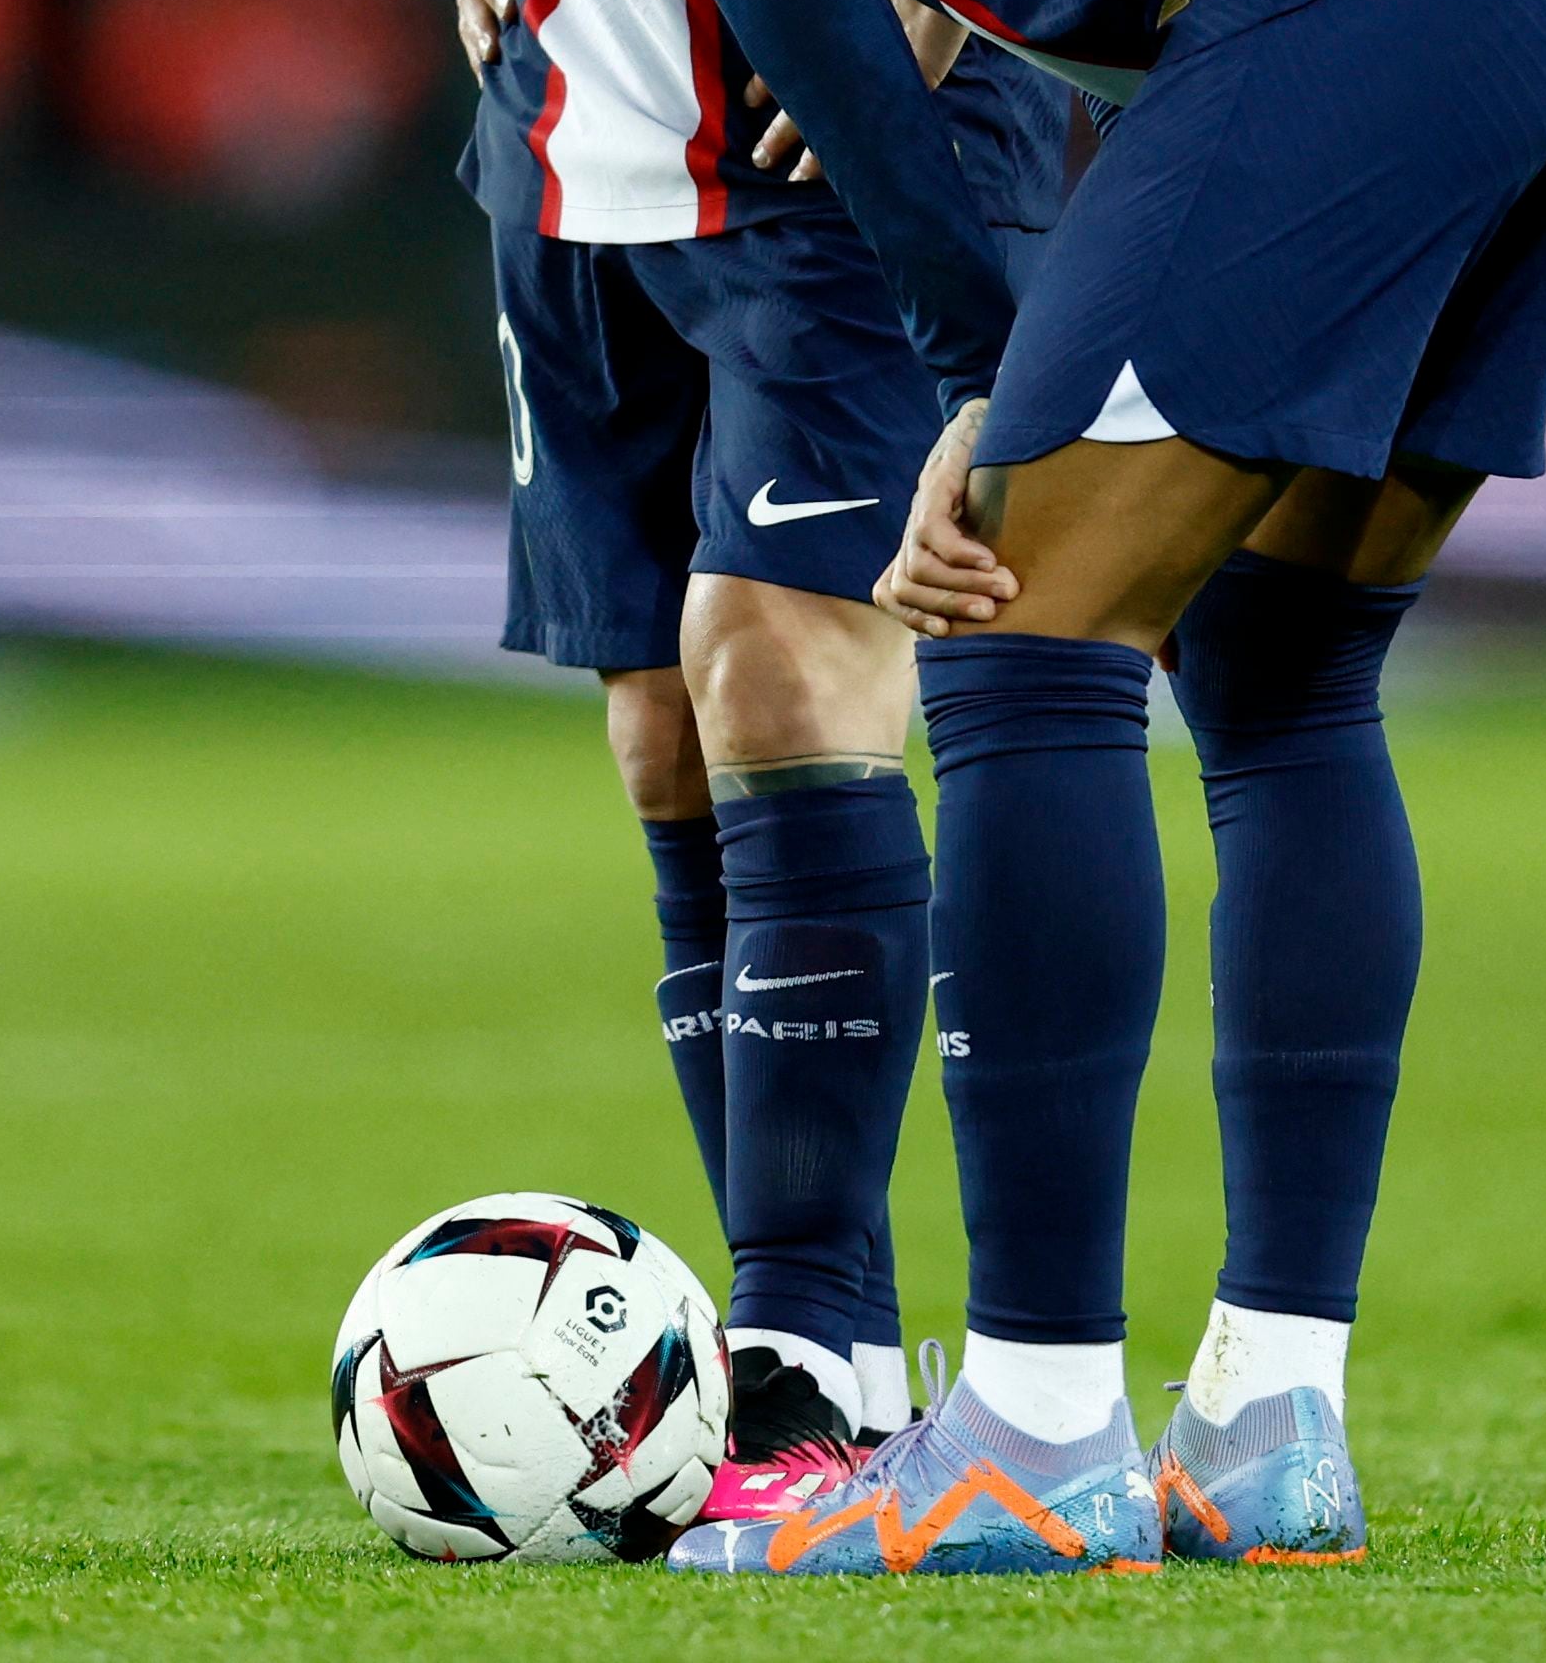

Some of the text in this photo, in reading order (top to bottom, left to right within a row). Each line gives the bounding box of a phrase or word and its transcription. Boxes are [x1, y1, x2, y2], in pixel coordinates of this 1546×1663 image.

[726, 1012, 881, 1041] PARIS
[565, 1318, 601, 1347] LIGUE
[575, 1343, 600, 1368] Eats
